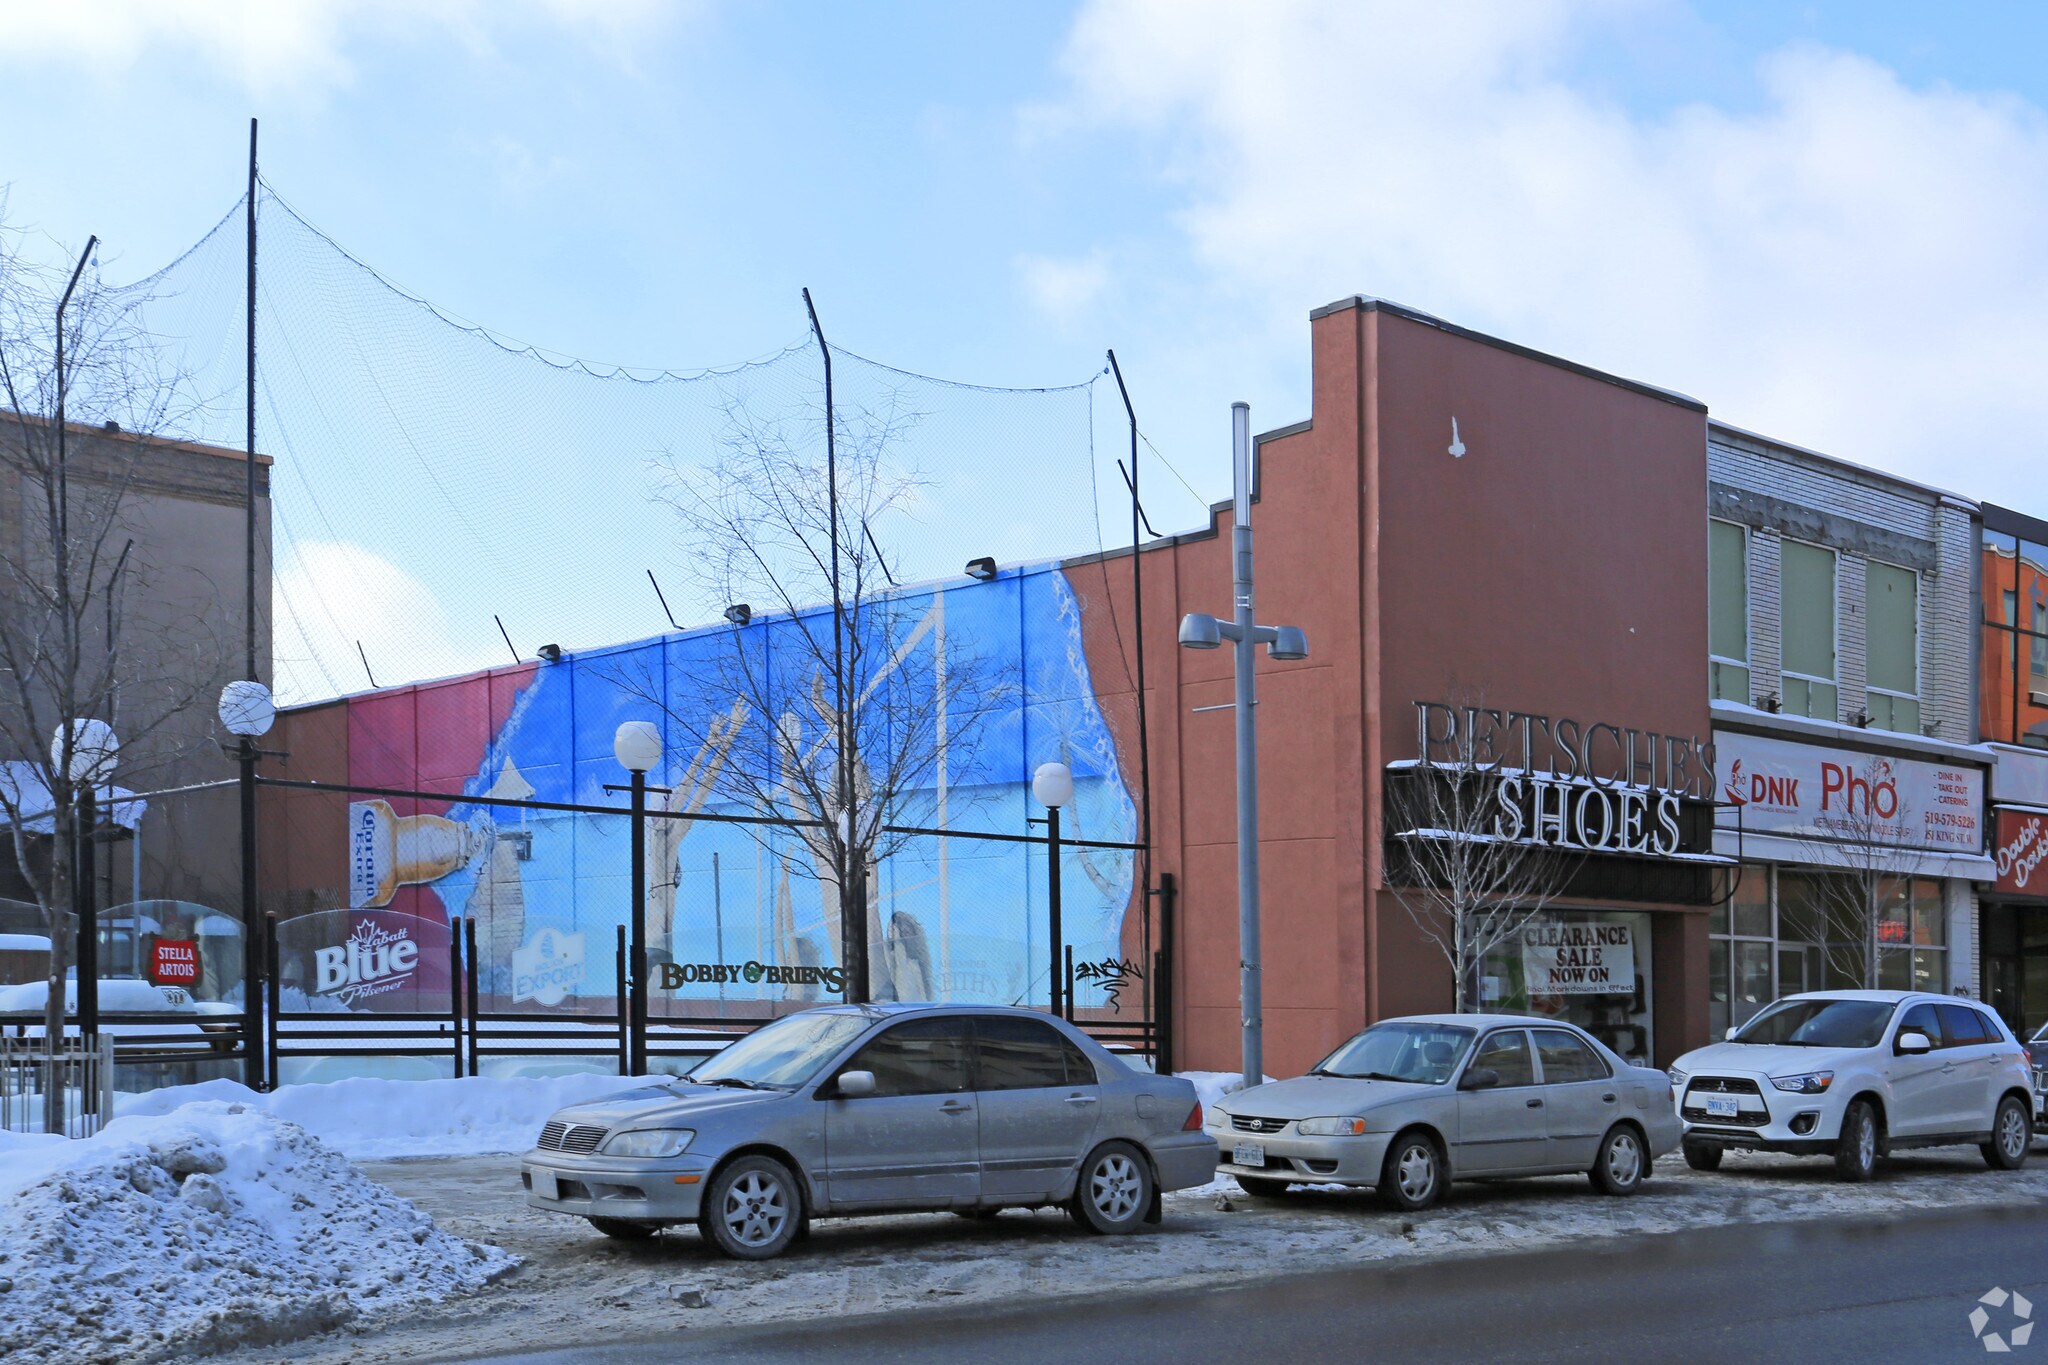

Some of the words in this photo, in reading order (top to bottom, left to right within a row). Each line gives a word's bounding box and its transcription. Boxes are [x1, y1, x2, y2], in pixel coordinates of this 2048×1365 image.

[1412, 700, 1717, 800] PETSCHE'S
[1938, 772, 1953, 781] DINE
[1955, 774, 1962, 782] IN
[1751, 773, 1799, 807] DNK
[1938, 784, 1953, 793] TAKE
[1955, 785, 1968, 795] OUT
[1938, 796, 1968, 806] CATERING
[1494, 776, 1680, 856] SHOES
[1924, 811, 1976, 829] 519-579-5226
[1936, 830, 1954, 843] KING
[1997, 818, 2041, 876] Double
[355, 833, 364, 883] Extra
[361, 810, 375, 897] Corona
[1525, 926, 1628, 947] CLEARANCE
[158, 946, 194, 961] STELLA
[1556, 948, 1602, 967] SALE
[158, 963, 195, 977] ARTOIS
[314, 939, 418, 993] Blue
[660, 962, 742, 990] BOBBY
[743, 960, 848, 993] O'BRIENS
[1549, 968, 1585, 983] NOW
[1588, 967, 1609, 983] ON
[516, 963, 581, 996] EXPORT
[1547, 984, 1598, 993] Markdowns
[340, 980, 405, 1007] Pilsener
